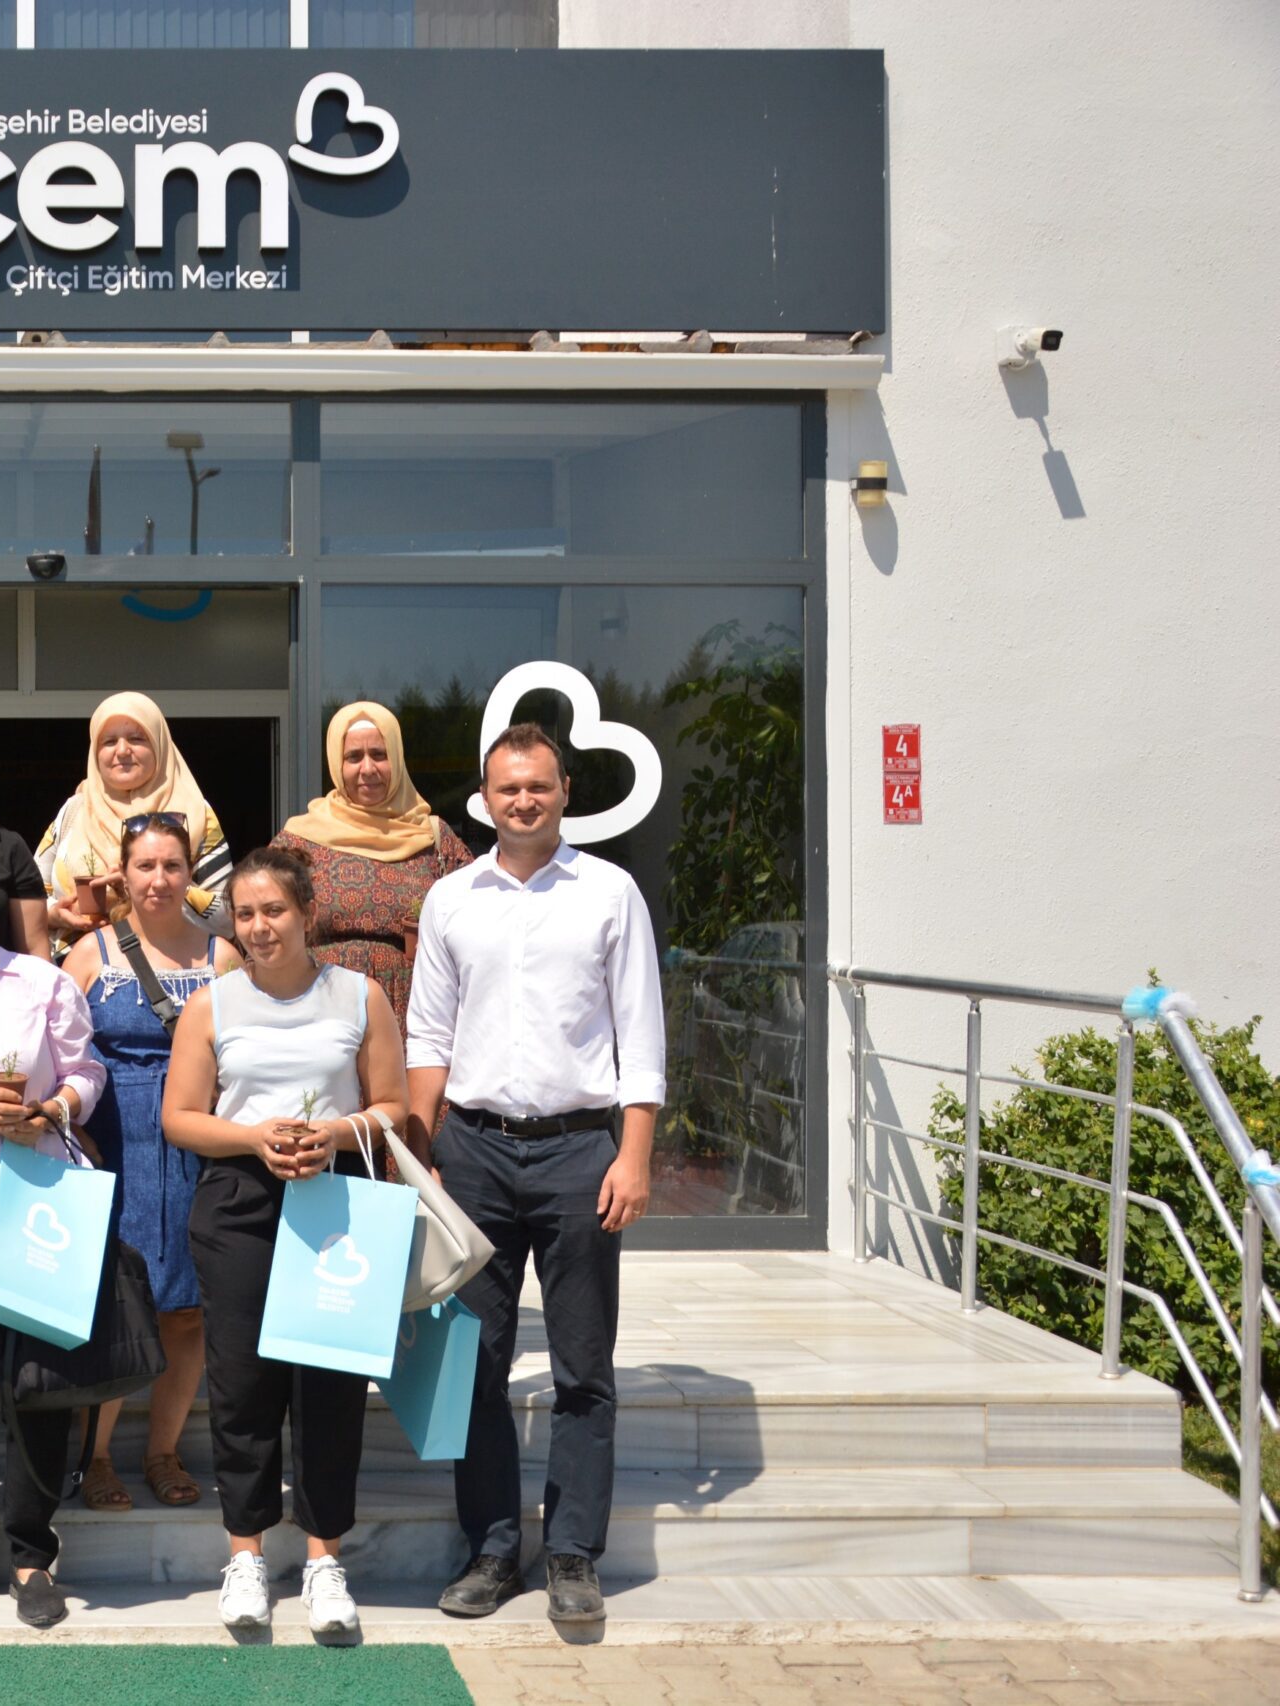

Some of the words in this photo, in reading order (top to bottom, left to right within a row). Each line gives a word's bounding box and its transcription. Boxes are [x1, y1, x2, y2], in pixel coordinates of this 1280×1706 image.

[68, 108, 207, 140] Belediyesi
[6, 264, 78, 296] Çiftçi
[88, 265, 173, 296] Eğitim
[182, 264, 287, 289] Merkezi
[895, 734, 907, 757] 4
